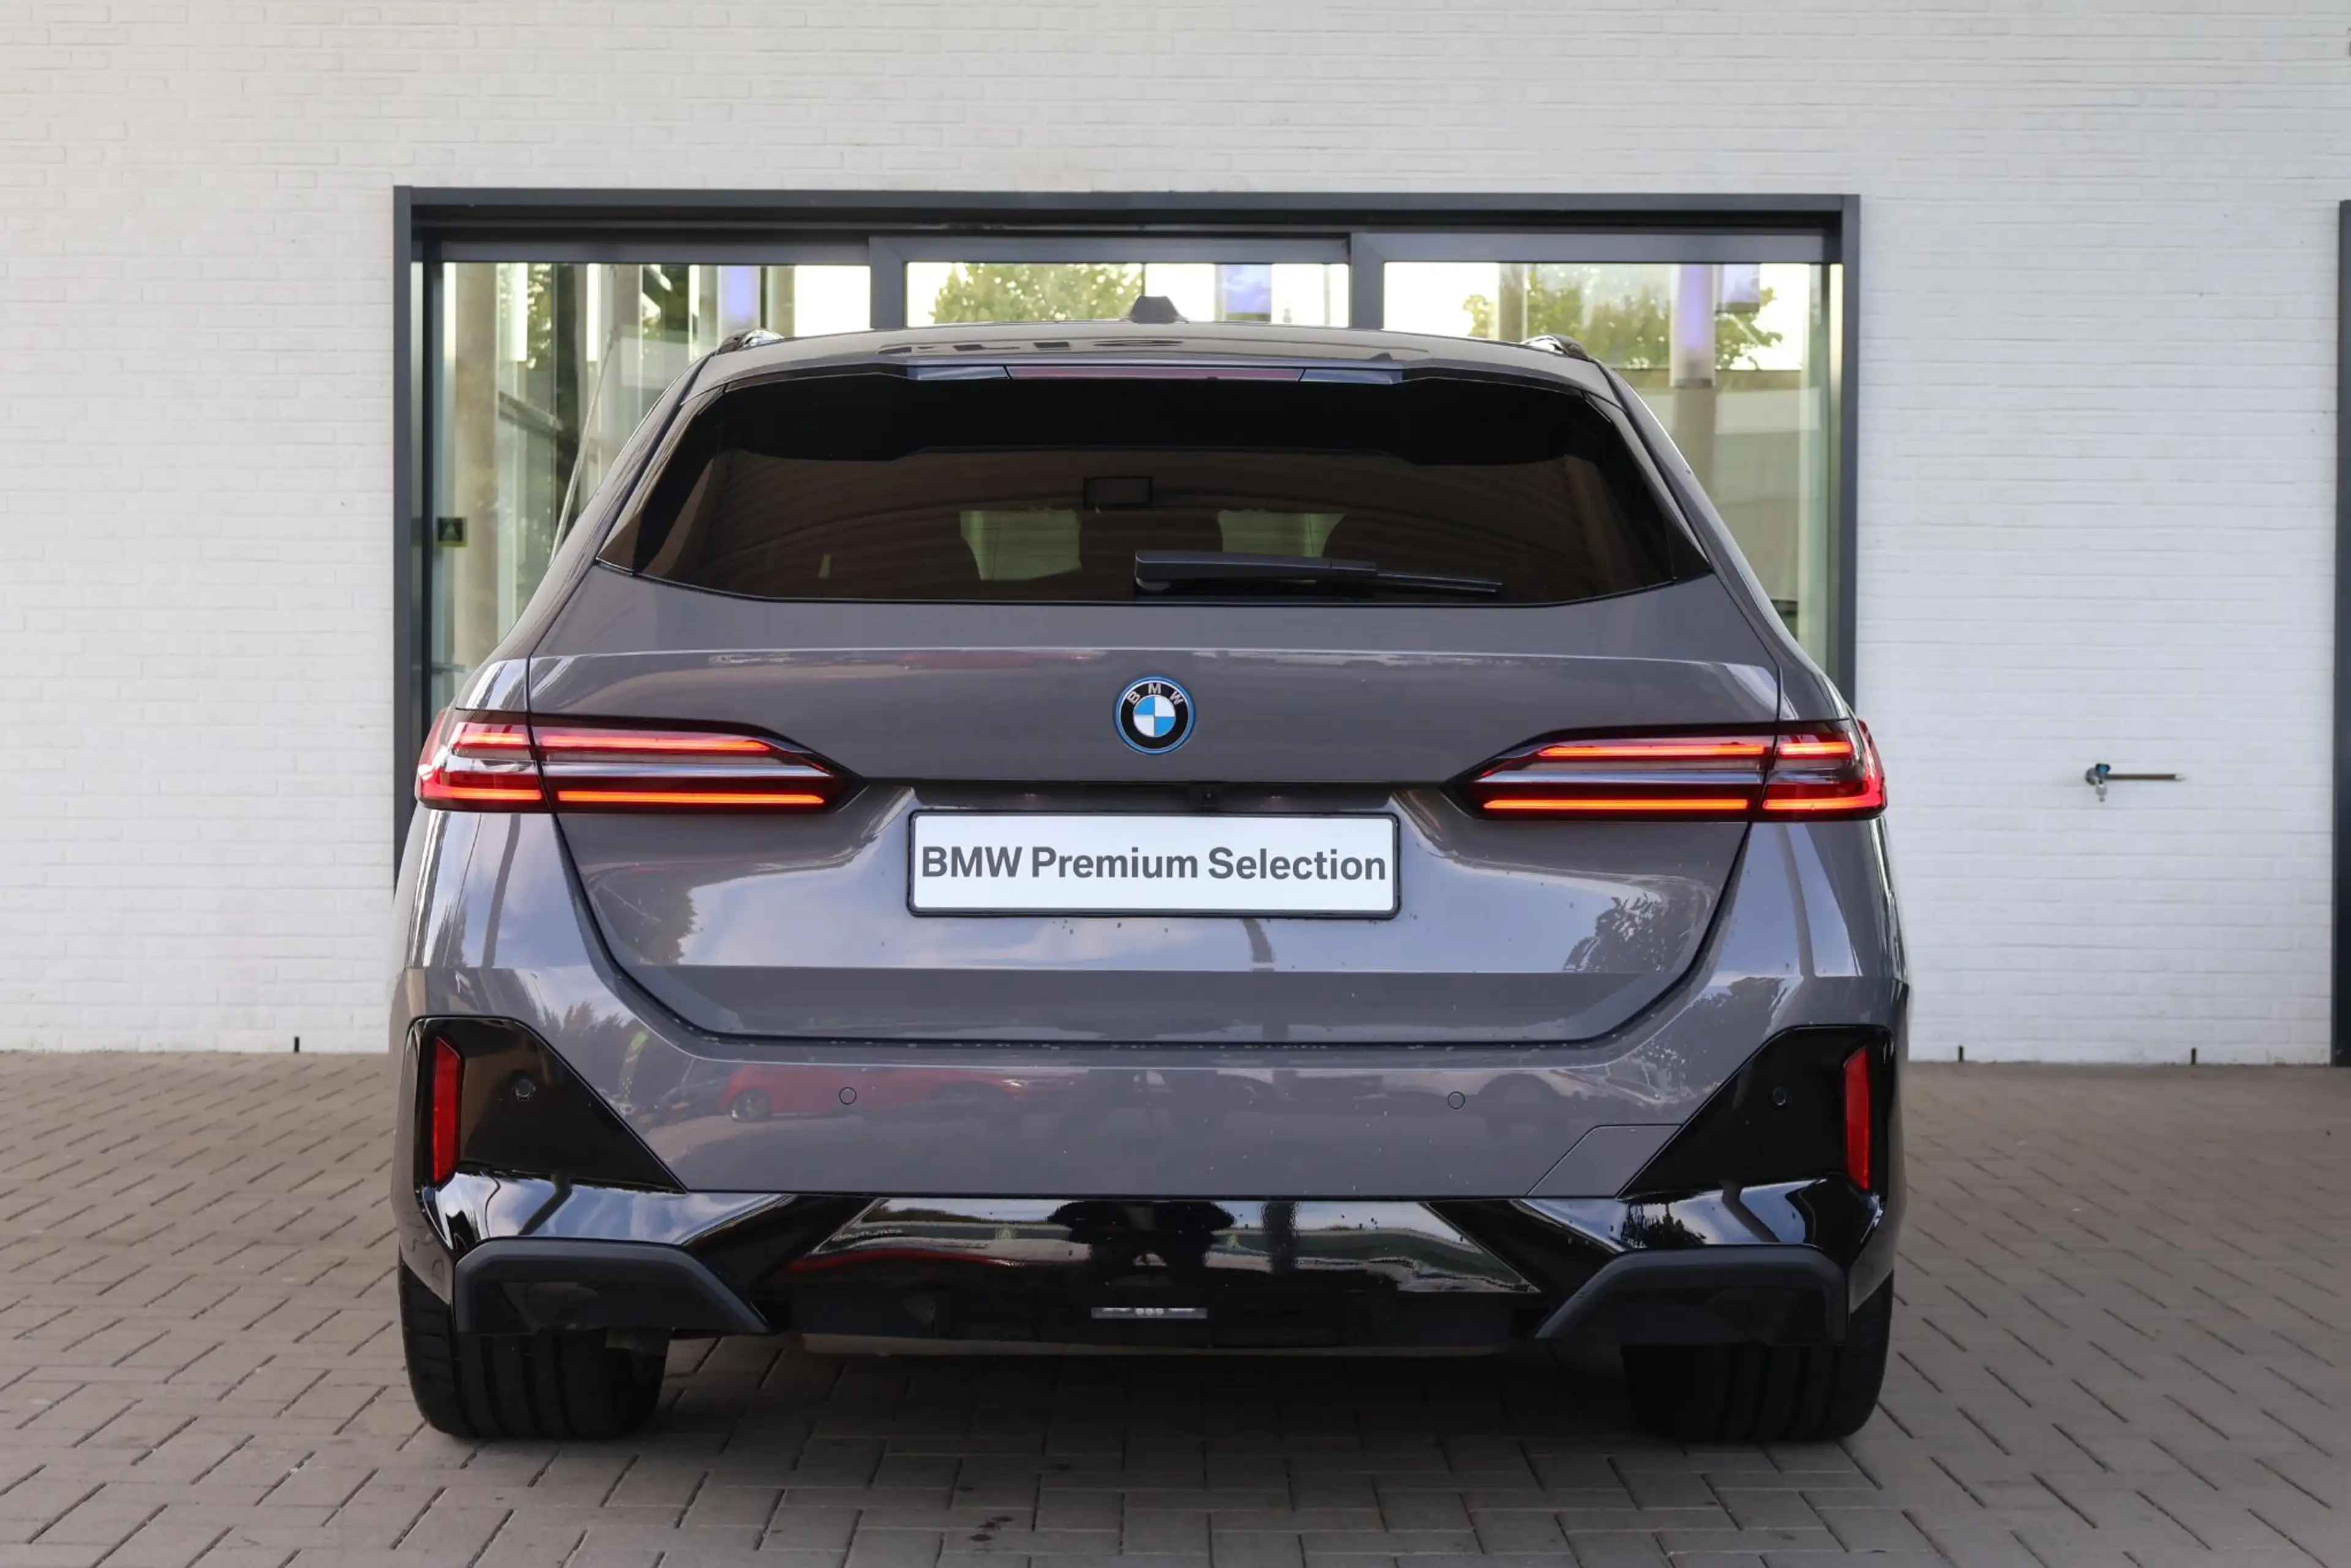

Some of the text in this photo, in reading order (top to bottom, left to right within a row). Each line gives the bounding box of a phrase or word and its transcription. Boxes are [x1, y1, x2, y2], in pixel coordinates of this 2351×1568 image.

[1126, 682, 1185, 705] BMW
[922, 846, 1385, 880] BMW Premium Selection
